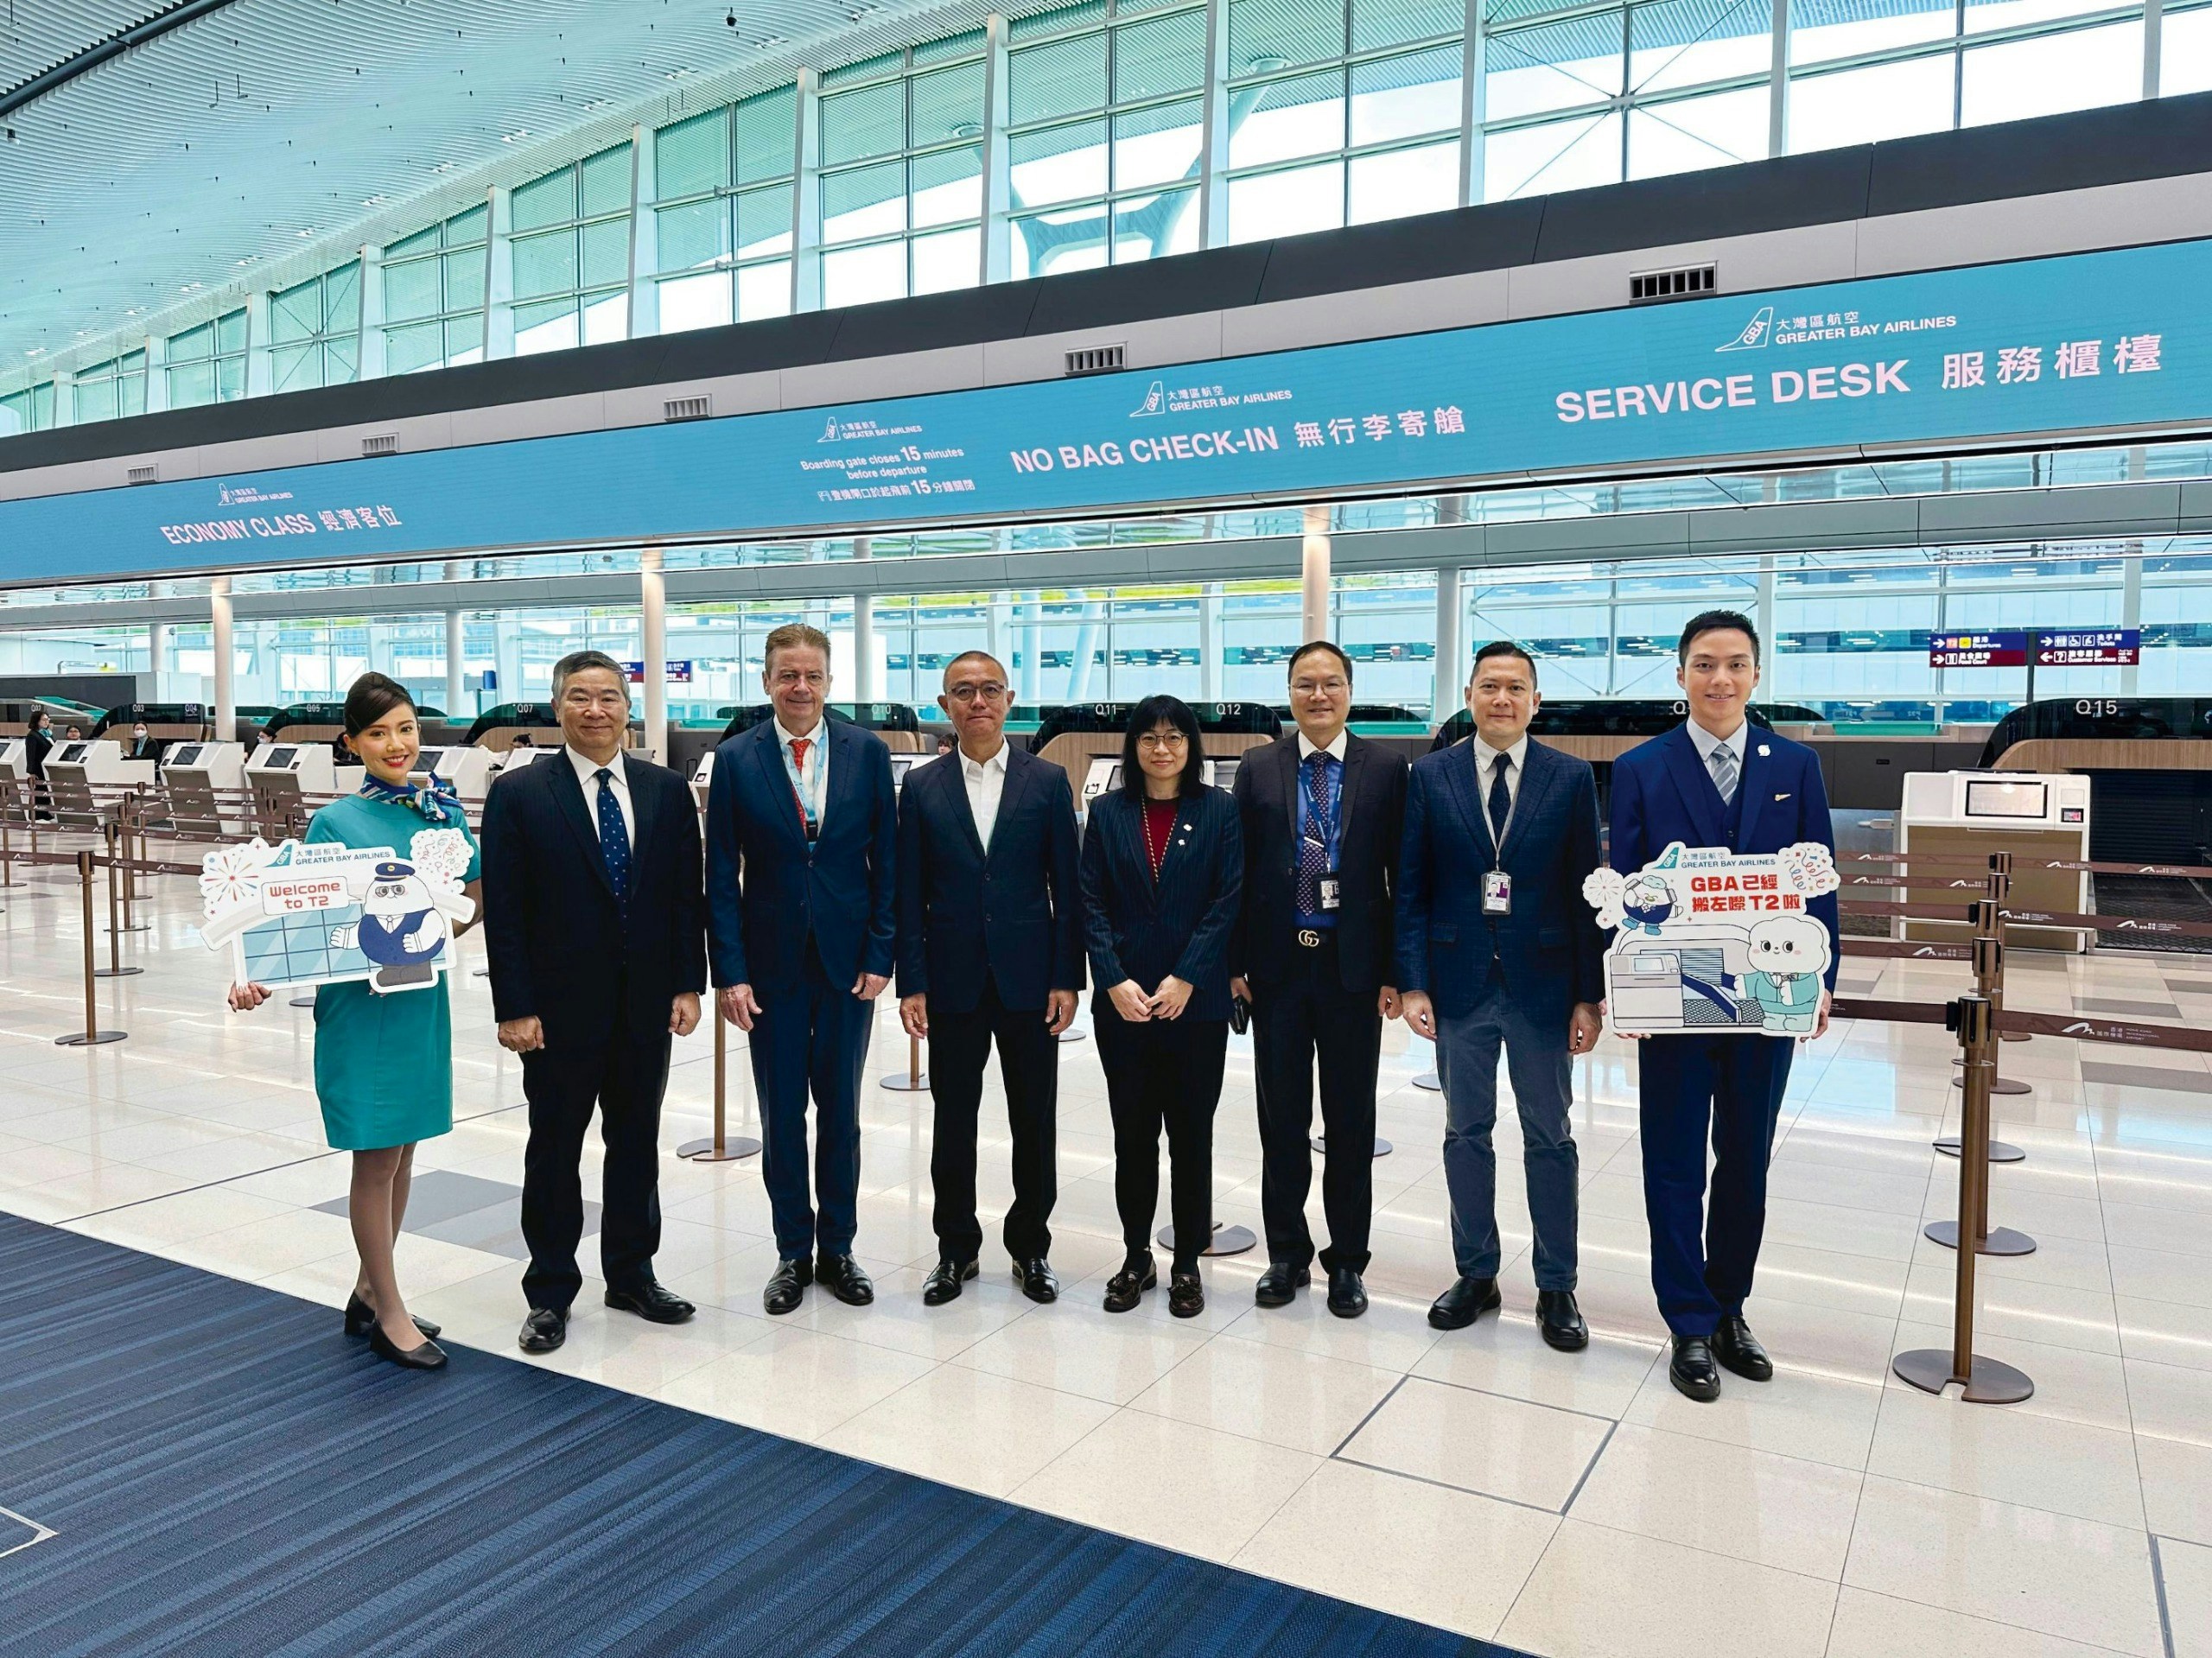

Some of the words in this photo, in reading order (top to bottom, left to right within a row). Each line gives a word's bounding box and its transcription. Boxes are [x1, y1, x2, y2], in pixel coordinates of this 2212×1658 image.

[1776, 310, 1859, 331] 大灣區航空
[1742, 320, 1768, 346] GBA
[1776, 327, 1846, 345] GREATER
[1849, 323, 1882, 338] BAY
[1885, 315, 1957, 334] AIRLINES
[1555, 375, 1756, 422] SERVICE
[1770, 359, 1911, 403] DESK
[1942, 334, 2162, 390] 服務櫃檯
[1167, 385, 1224, 400] 大灣區航空
[1169, 398, 1217, 412] GREATER
[1219, 396, 1240, 407] BAY
[1243, 390, 1293, 404] AIRLINES
[842, 429, 875, 440] GREATER
[874, 428, 890, 437] BAY
[890, 425, 923, 434] AIRLINES
[1010, 448, 1054, 473] NO
[1058, 441, 1124, 469] BAG
[1129, 426, 1280, 463] CHECK-IN
[1294, 405, 1465, 448] 無行李寄艙
[800, 460, 845, 471] Boarding
[846, 457, 867, 469] gate
[868, 454, 901, 465] closes
[900, 446, 921, 461] 15
[923, 448, 964, 460] minutes
[846, 469, 878, 480] before
[880, 465, 927, 479] departure
[911, 480, 931, 495] 15
[160, 519, 251, 544] ECONOMY
[250, 514, 316, 537] CLASS
[317, 505, 402, 532] 經濟客位
[132, 704, 144, 713] Q03
[306, 703, 321, 712] Q05
[518, 703, 533, 714] Q07
[872, 704, 891, 715] Q10
[1095, 703, 1116, 715] Q11
[1216, 703, 1241, 715] Q12
[2075, 699, 2117, 715] Q15
[296, 856, 334, 865] GREATER
[354, 851, 391, 860] AIRLINES
[1738, 858, 1776, 867] AIRLINES
[270, 882, 340, 897] Welcome
[1691, 876, 1739, 892] GBA
[284, 898, 302, 909] to
[308, 895, 329, 907] T2
[1749, 894, 1780, 911] T2
